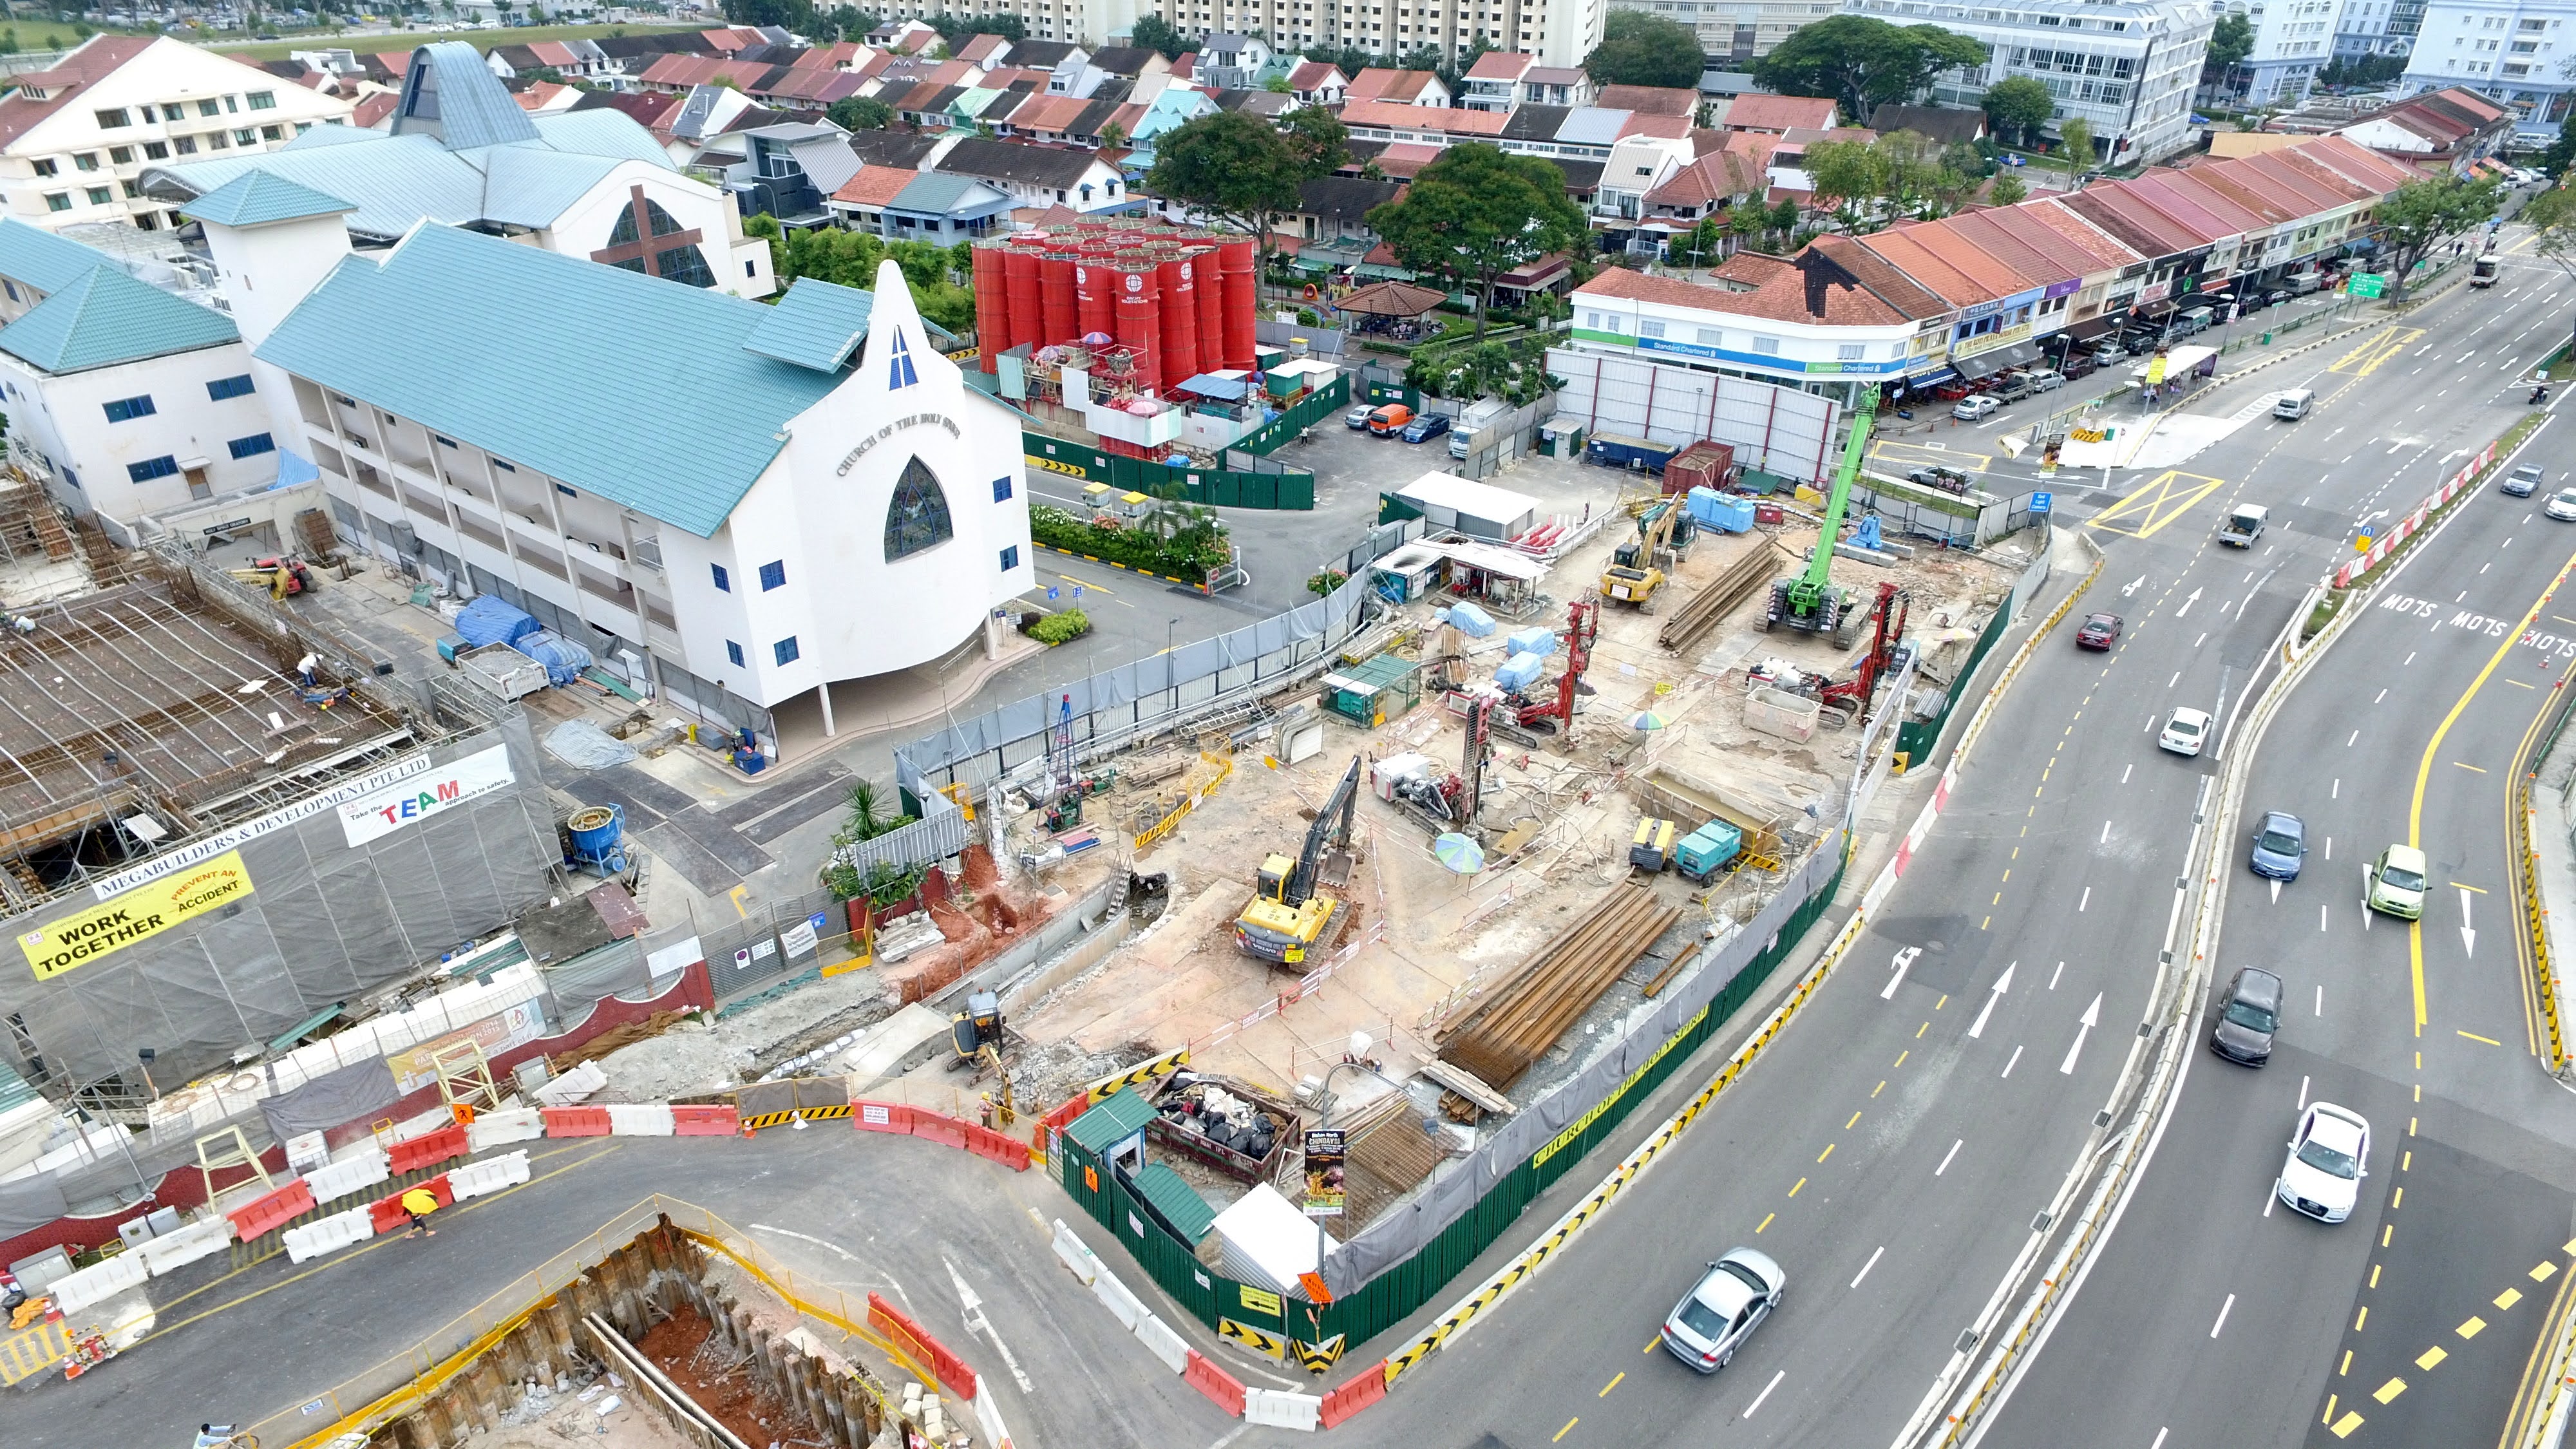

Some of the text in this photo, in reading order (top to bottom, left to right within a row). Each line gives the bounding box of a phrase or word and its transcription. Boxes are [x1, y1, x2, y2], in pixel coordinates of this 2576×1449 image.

[1654, 342, 1710, 357] Standard Chartered
[1815, 364, 1874, 373] Standard Chartered
[837, 413, 961, 477] CHURCH OF THE HOLY SPIRIT
[2380, 592, 2439, 618] SLOW
[2449, 611, 2508, 637] SLOW
[350, 810, 369, 821] Take
[370, 804, 383, 813] the
[379, 780, 460, 825] TEAM
[444, 788, 477, 806] approach
[100, 831, 235, 896] MEGABUILDERS
[240, 826, 251, 840] &
[254, 784, 366, 834] DEVELOPMENT
[364, 771, 397, 794] PTE
[399, 759, 426, 781] LTD
[171, 871, 218, 901] PREVENT
[178, 880, 240, 913] ACCIDENT
[58, 909, 132, 945] WORK
[39, 914, 165, 972] TOGETHER
[1253, 943, 1276, 954] VOLVO
[481, 1020, 498, 1030] 2014
[483, 1025, 500, 1037] 2015
[1535, 1006, 1709, 1164] CHURCH OF THE HOLY SPIRIT
